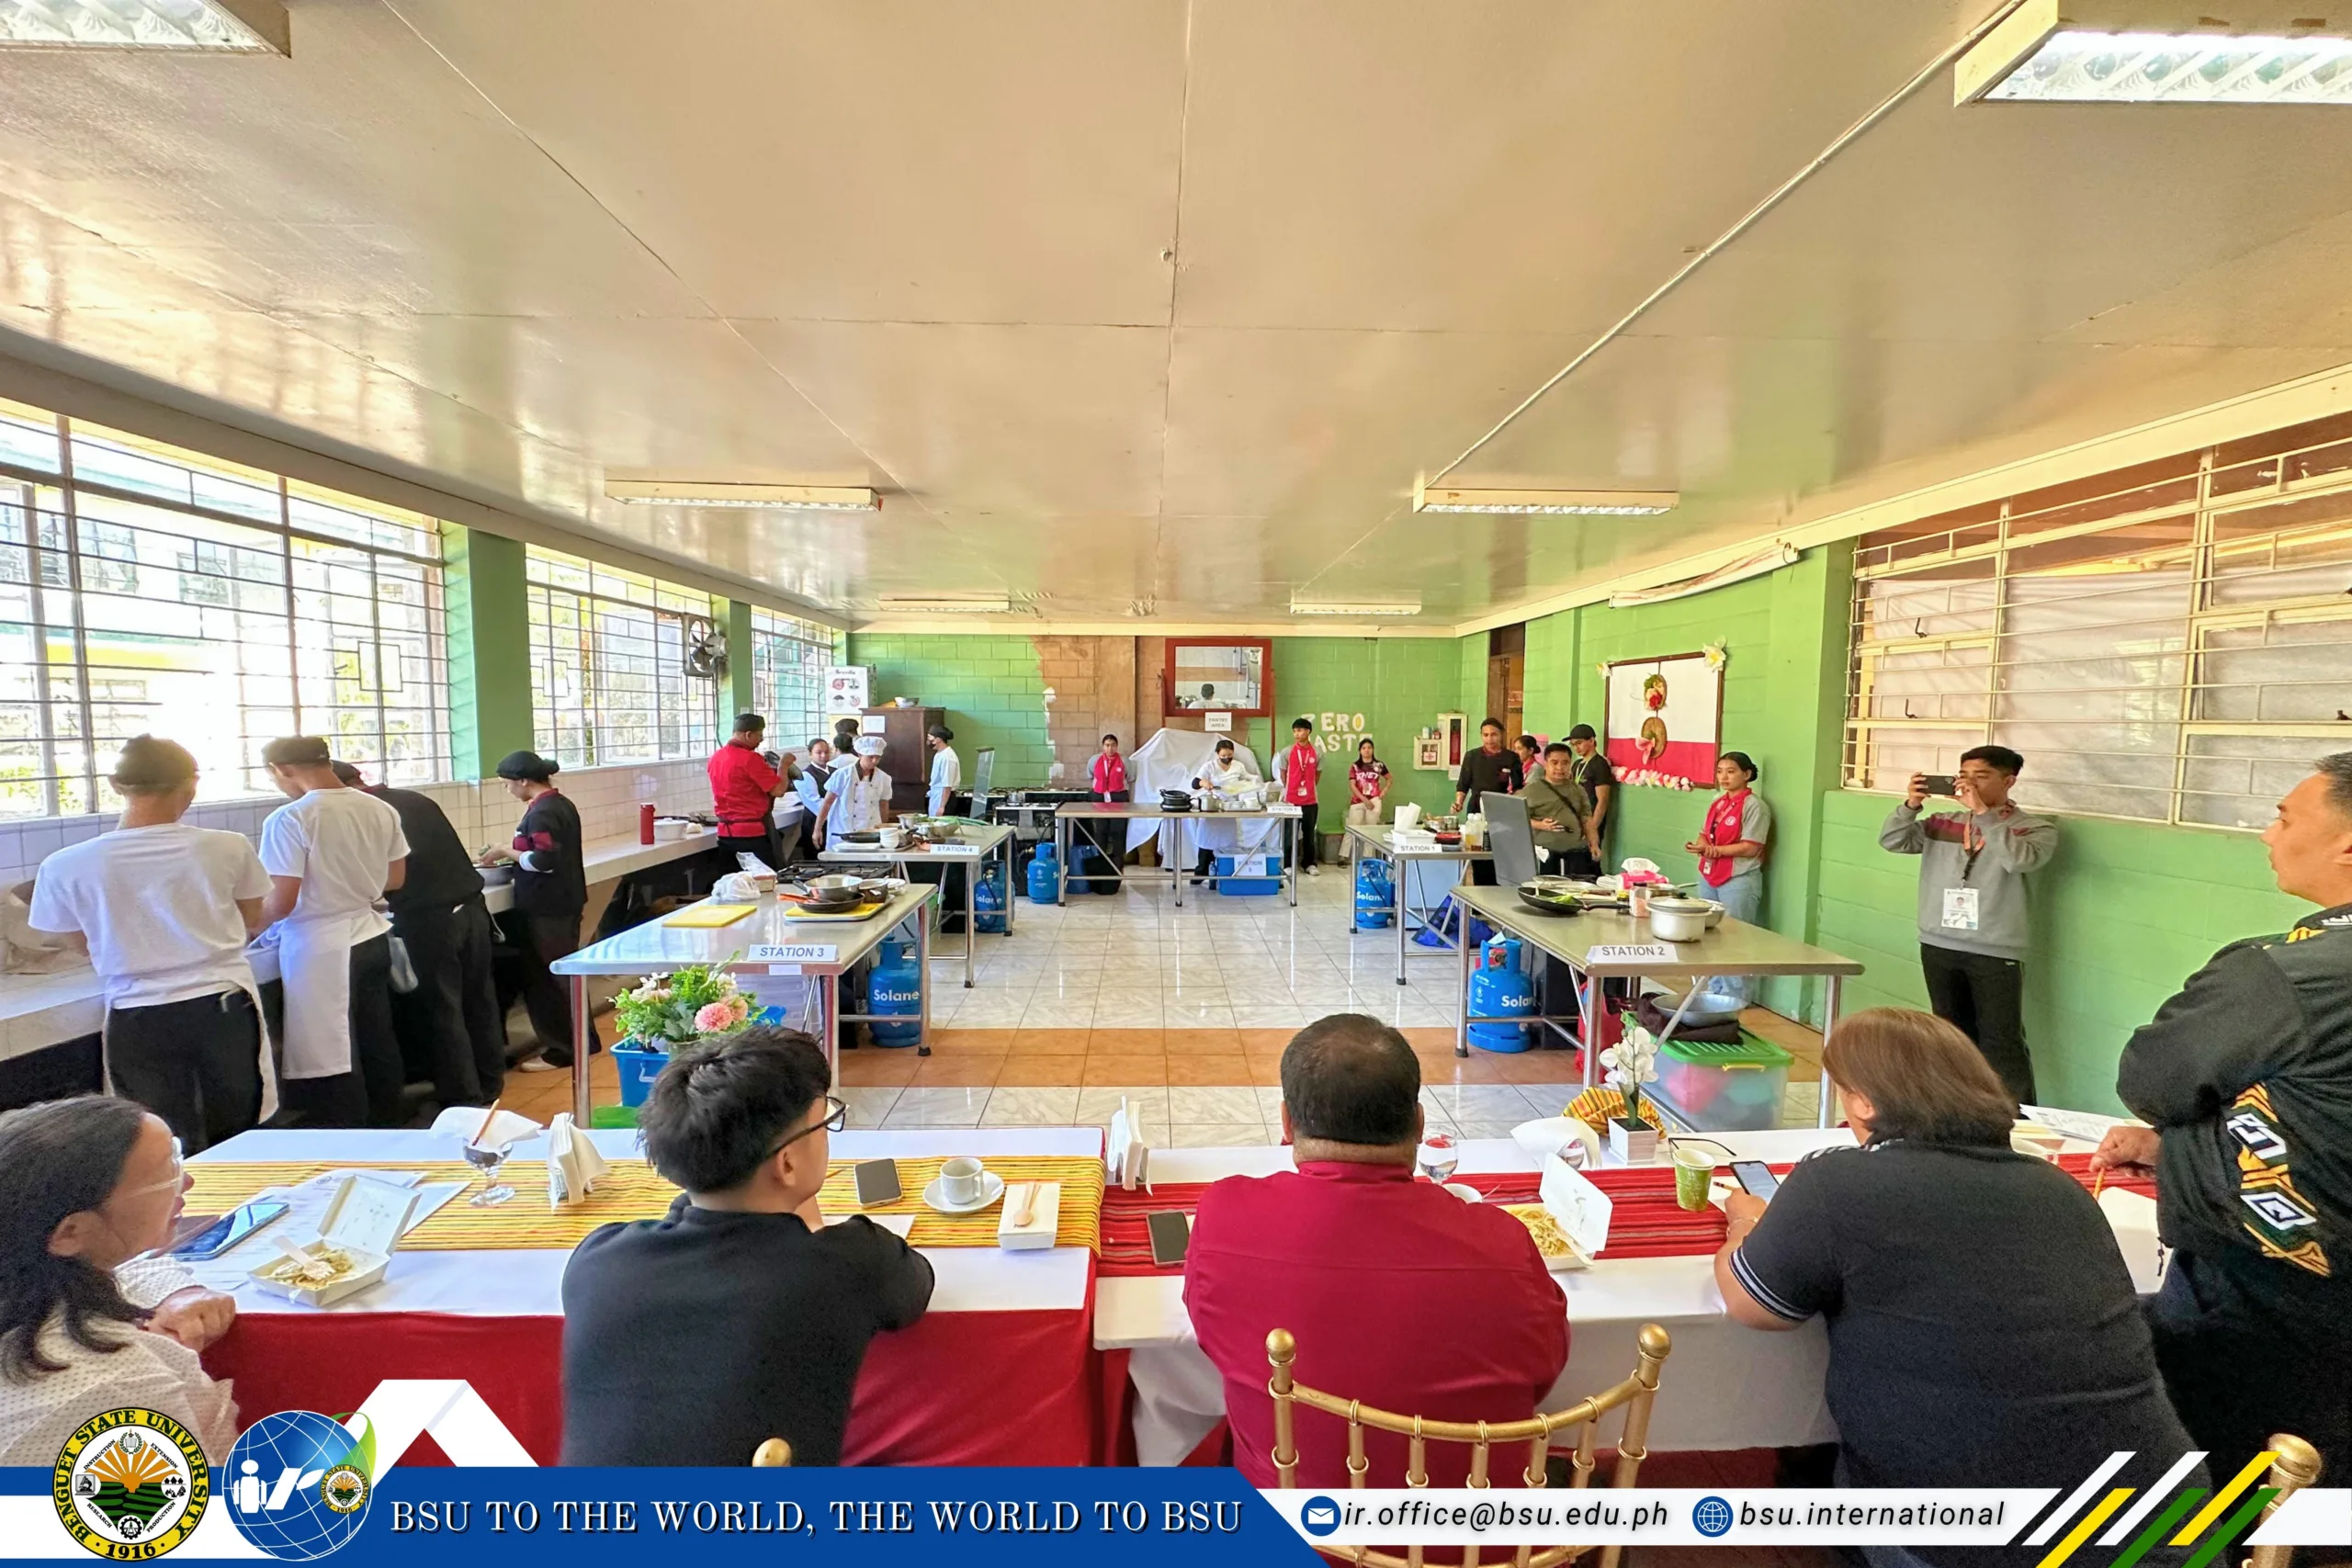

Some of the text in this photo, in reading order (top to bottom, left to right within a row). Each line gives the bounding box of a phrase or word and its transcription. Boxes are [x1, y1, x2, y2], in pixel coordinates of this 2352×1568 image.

[1308, 733, 1373, 753] AST
[937, 845, 967, 853] STATION
[760, 947, 825, 957] STATION 3
[1601, 946, 1666, 956] STATION 2
[874, 988, 920, 1002] Solane
[1501, 995, 1533, 1008] Sola
